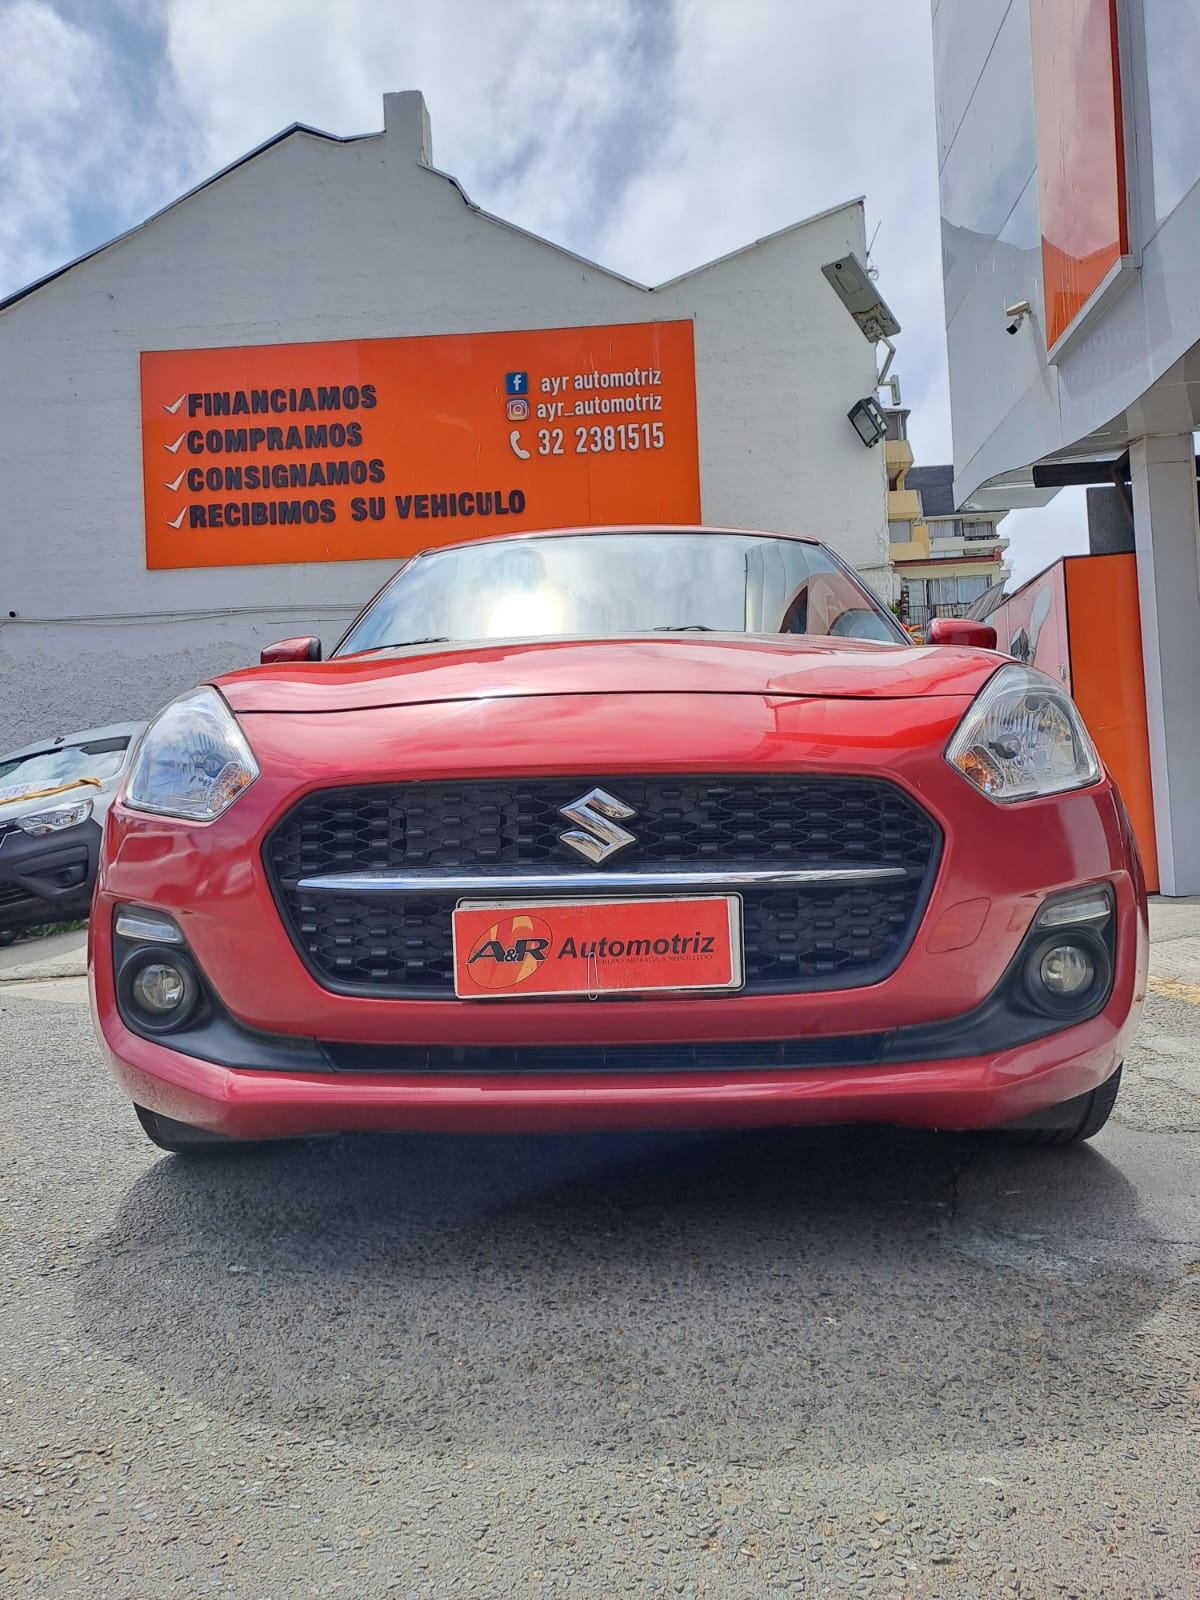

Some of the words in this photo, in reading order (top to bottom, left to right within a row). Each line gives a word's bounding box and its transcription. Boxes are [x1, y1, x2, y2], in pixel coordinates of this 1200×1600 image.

[541, 376, 569, 396] ayr
[574, 367, 662, 390] automotriz
[188, 384, 377, 417] FINANCIAMOS
[537, 393, 663, 422] ayr_automotriz
[187, 422, 363, 454] COMPRAMOS
[538, 428, 564, 455] 32
[575, 422, 664, 454] 2381515
[187, 459, 385, 492] CONSIGNAMOS
[189, 499, 337, 528] RECIBIMOS
[350, 496, 386, 521] SU
[395, 489, 526, 519] VEHICULO
[466, 938, 549, 963] A&R
[557, 931, 715, 959] Automotriz
